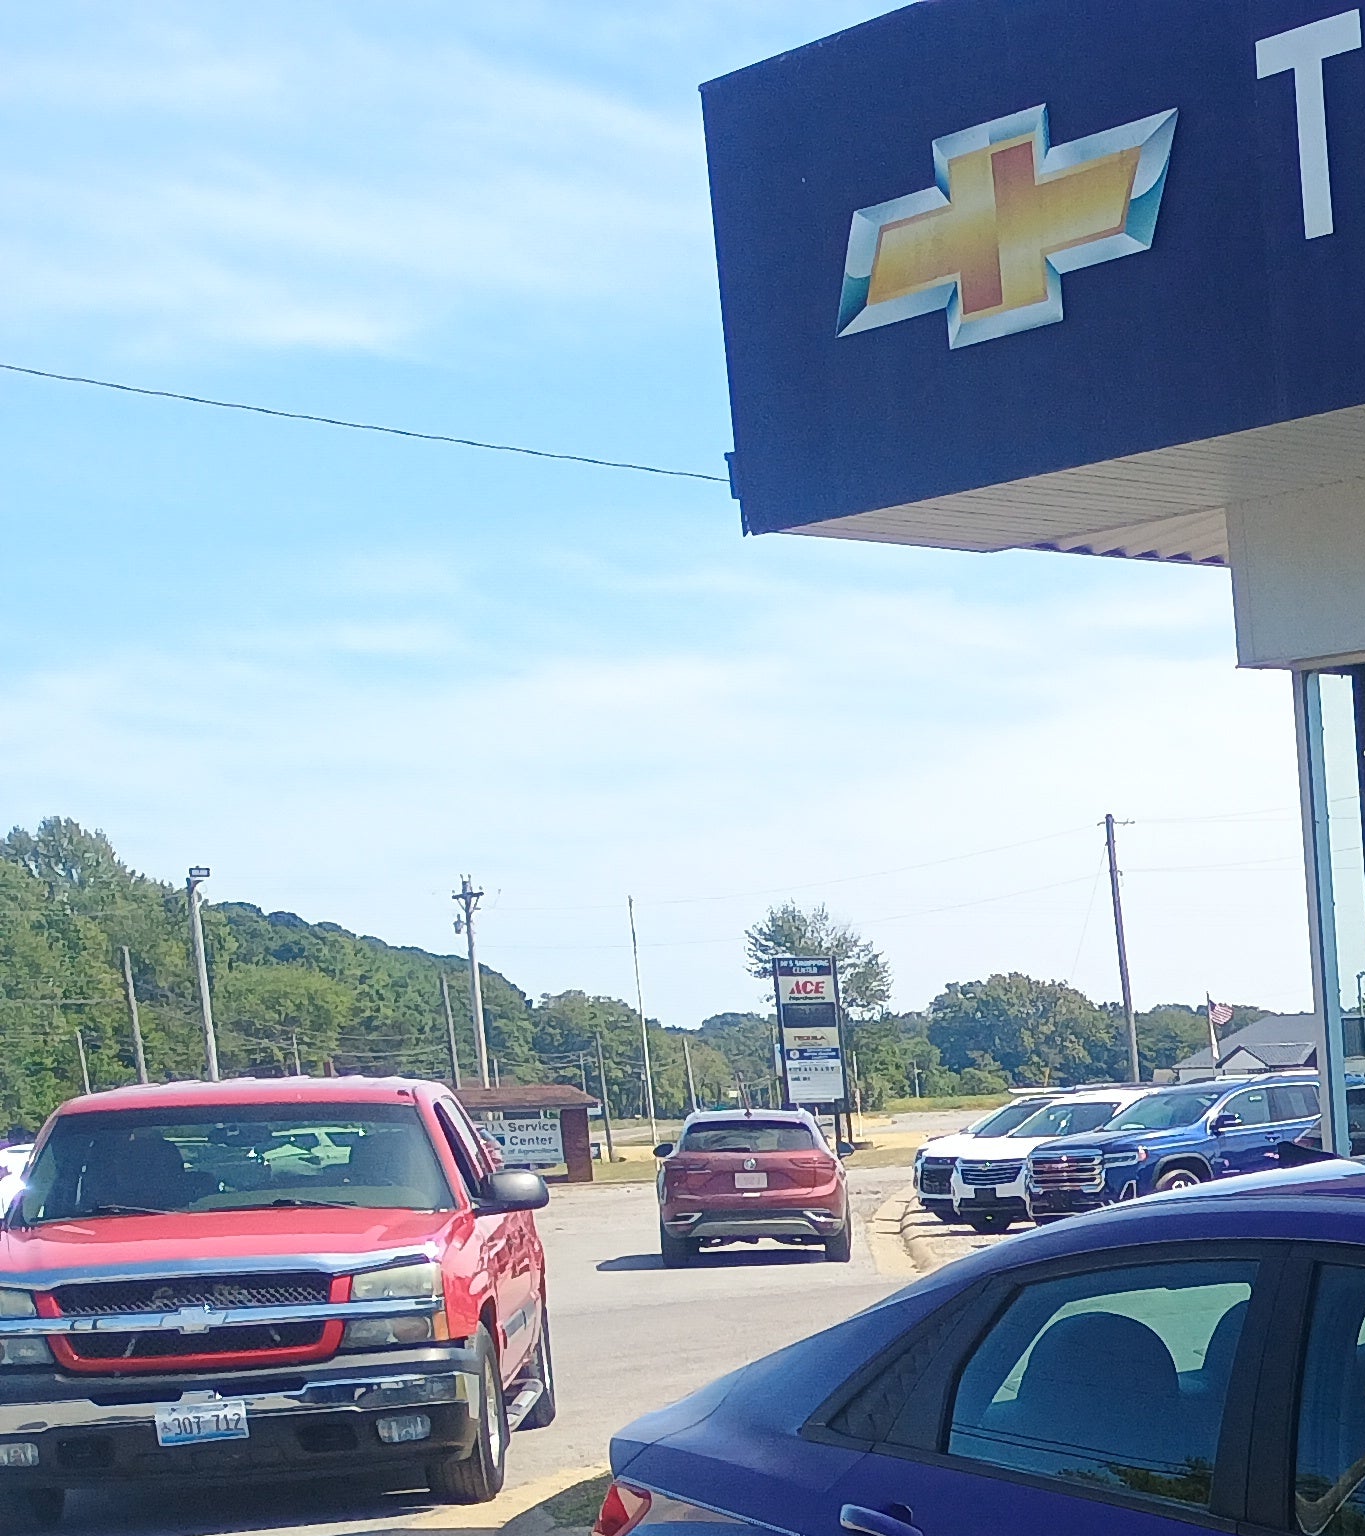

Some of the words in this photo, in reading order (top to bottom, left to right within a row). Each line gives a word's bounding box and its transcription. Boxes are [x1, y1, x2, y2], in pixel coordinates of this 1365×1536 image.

[789, 979, 826, 995] ACE
[507, 1120, 558, 1133] Service
[509, 1135, 554, 1146] Center
